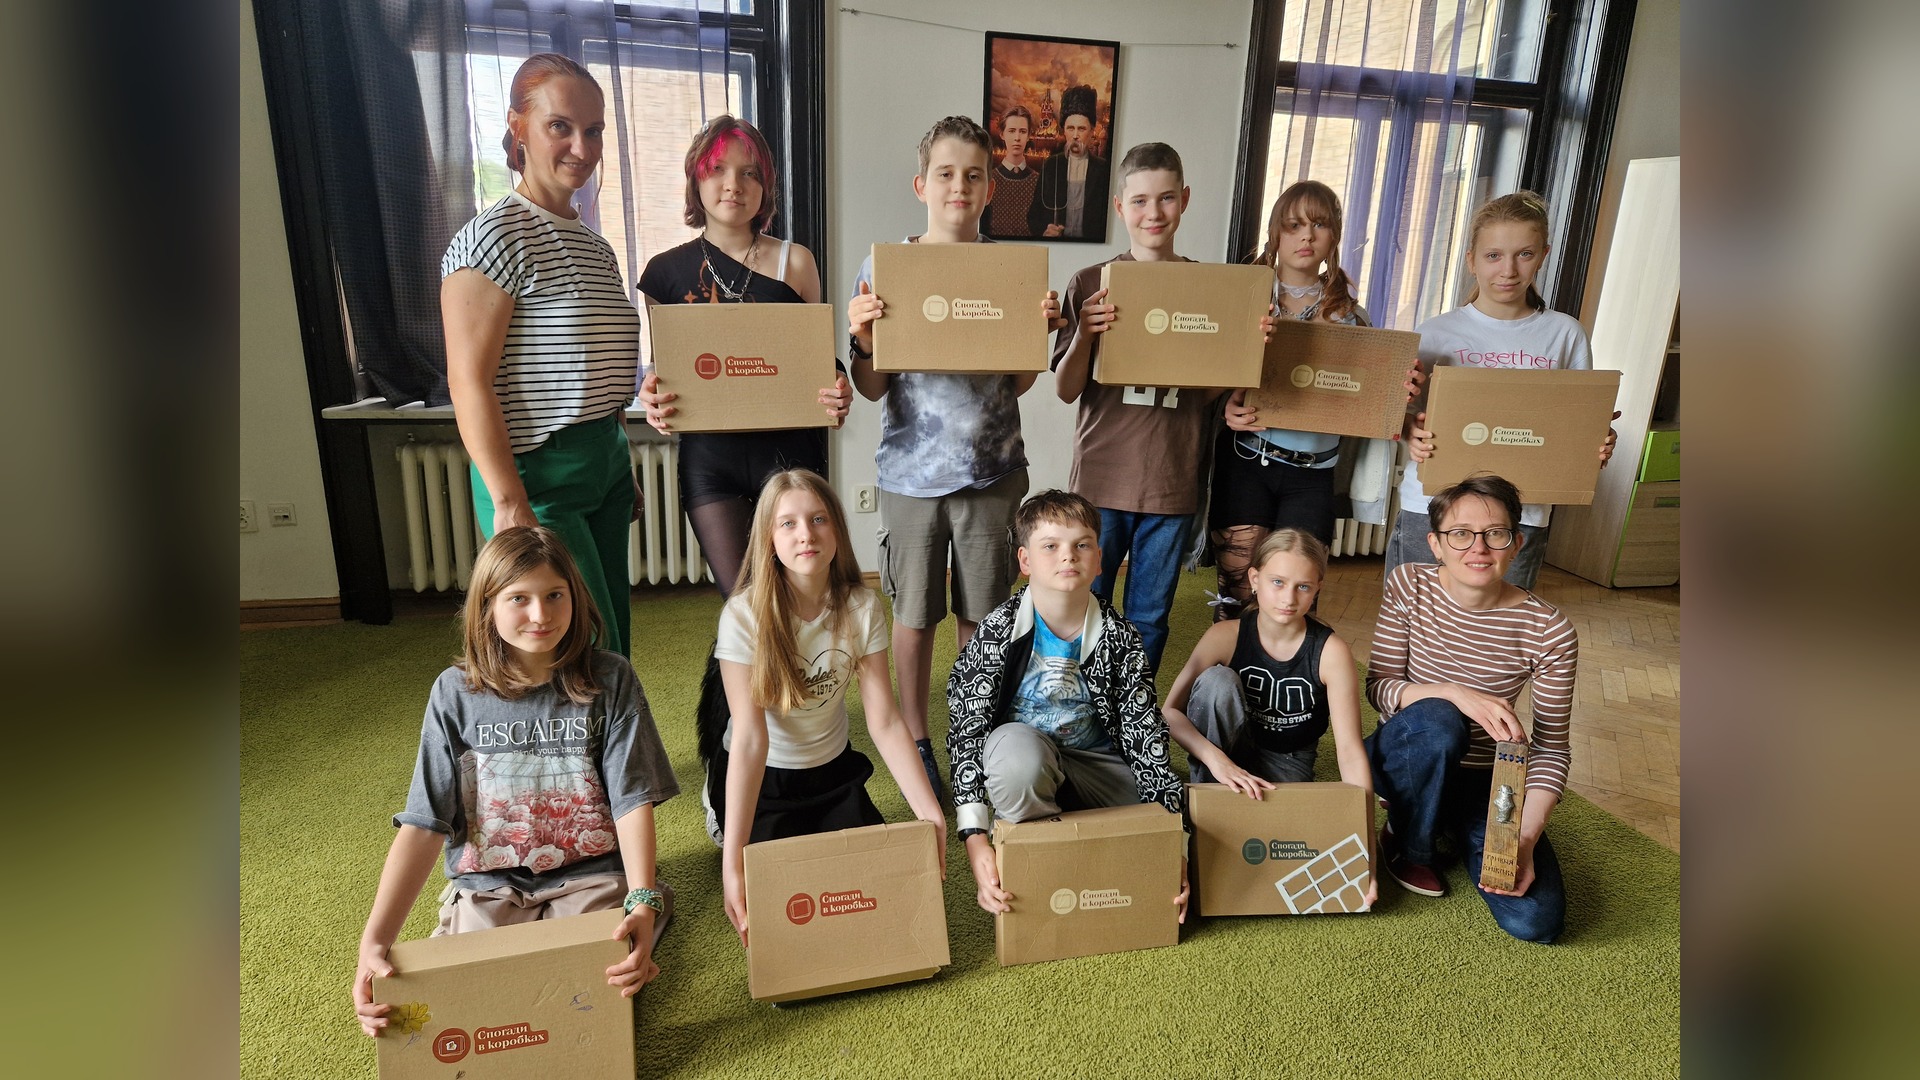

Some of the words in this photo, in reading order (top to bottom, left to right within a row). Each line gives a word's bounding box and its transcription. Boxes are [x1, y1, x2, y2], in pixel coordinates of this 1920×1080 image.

[954, 301, 989, 310] Спогади
[961, 310, 1001, 318] коробках
[1174, 315, 1207, 323] Спогади
[1179, 323, 1216, 331] коробках
[727, 358, 763, 367] Спогади
[1454, 348, 1557, 370] Together
[734, 366, 776, 375] коробках
[984, 643, 1000, 655] KAW
[816, 683, 833, 696] 1976
[1240, 666, 1315, 717] 90
[1288, 713, 1312, 724] STATE
[476, 715, 606, 747] ESCAPISM
[537, 747, 558, 757] your
[561, 746, 587, 754] happy
[1271, 842, 1305, 850] Спогади
[1278, 850, 1317, 859] коробках
[822, 893, 861, 903] Спогади
[1082, 892, 1118, 900] Спогади
[830, 901, 875, 912] коробках
[1089, 898, 1129, 907] коробках
[477, 1025, 528, 1040] Спогади
[488, 1033, 545, 1049] коробках
